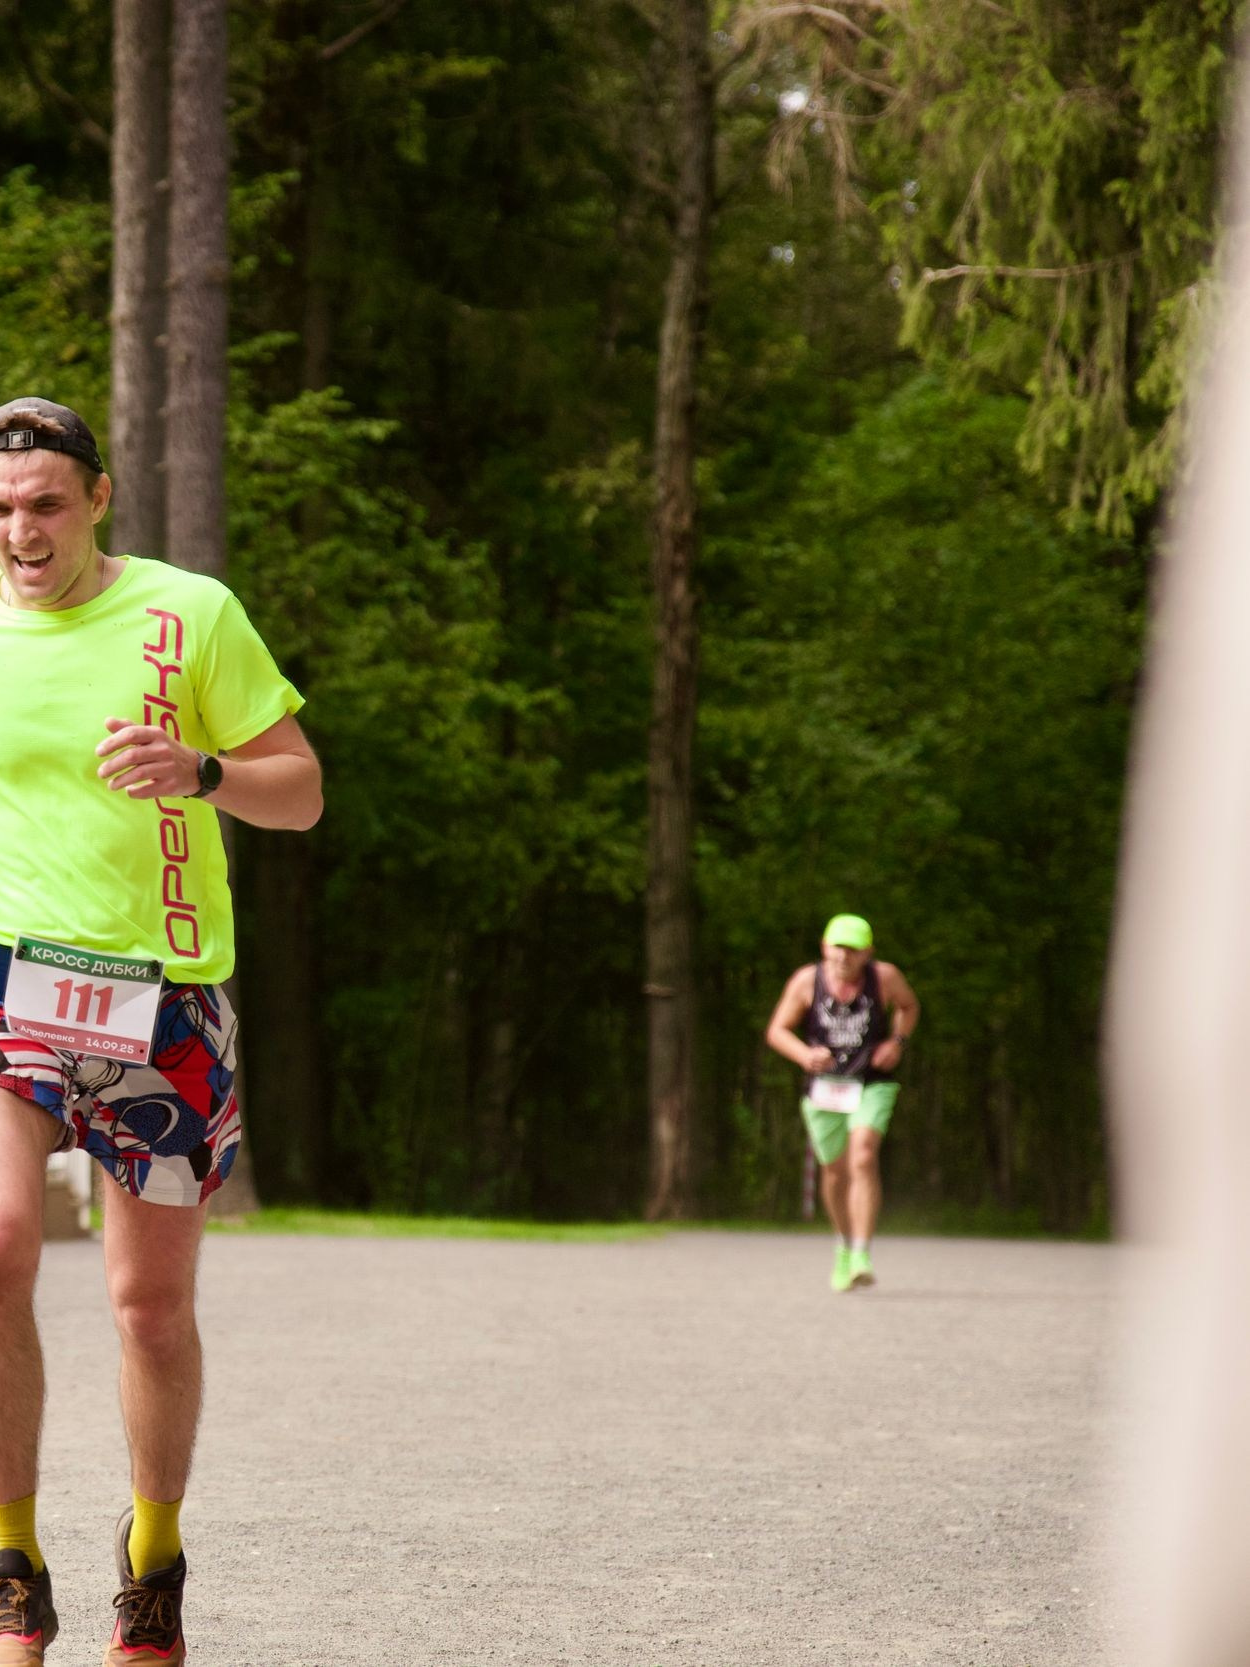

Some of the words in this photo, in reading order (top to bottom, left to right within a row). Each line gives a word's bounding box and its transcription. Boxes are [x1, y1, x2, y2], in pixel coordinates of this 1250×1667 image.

[31, 946, 90, 970] КРОСС
[91, 960, 149, 978] ДУБКИ
[53, 978, 114, 1027] 111
[20, 1025, 76, 1043] Апрелевка
[85, 1037, 135, 1055] 14.09.25
